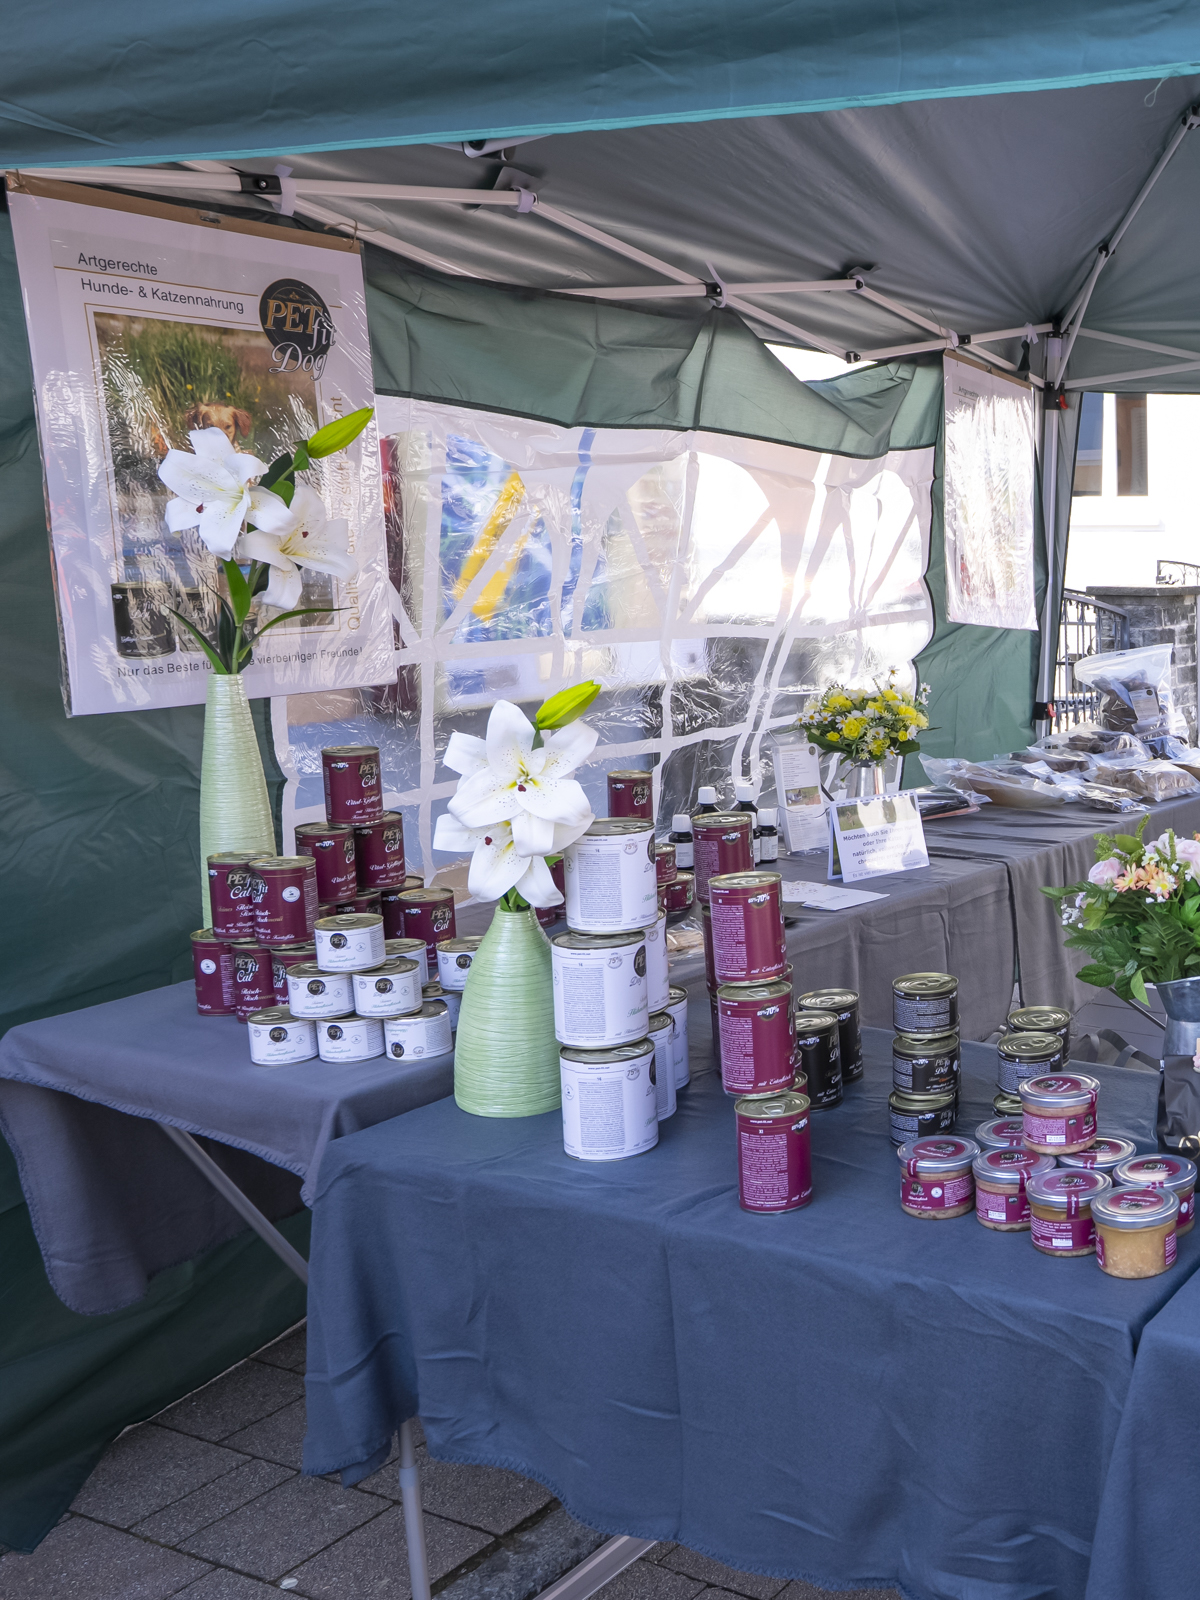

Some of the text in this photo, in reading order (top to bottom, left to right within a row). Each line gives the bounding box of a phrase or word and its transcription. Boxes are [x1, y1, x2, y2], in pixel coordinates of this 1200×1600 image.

[78, 252, 158, 275] Artgerechte
[81, 278, 244, 314] Hunde- & Katzennahrung
[264, 299, 323, 333] PET
[308, 317, 337, 350] fit
[269, 341, 327, 380] Dog
[118, 668, 139, 677] Nur
[144, 666, 164, 675] das
[167, 662, 199, 672] Beste
[202, 661, 212, 670] fü
[258, 651, 317, 664] vierbeinigen
[320, 647, 362, 659] Freunde!
[843, 833, 866, 841] Möchten
